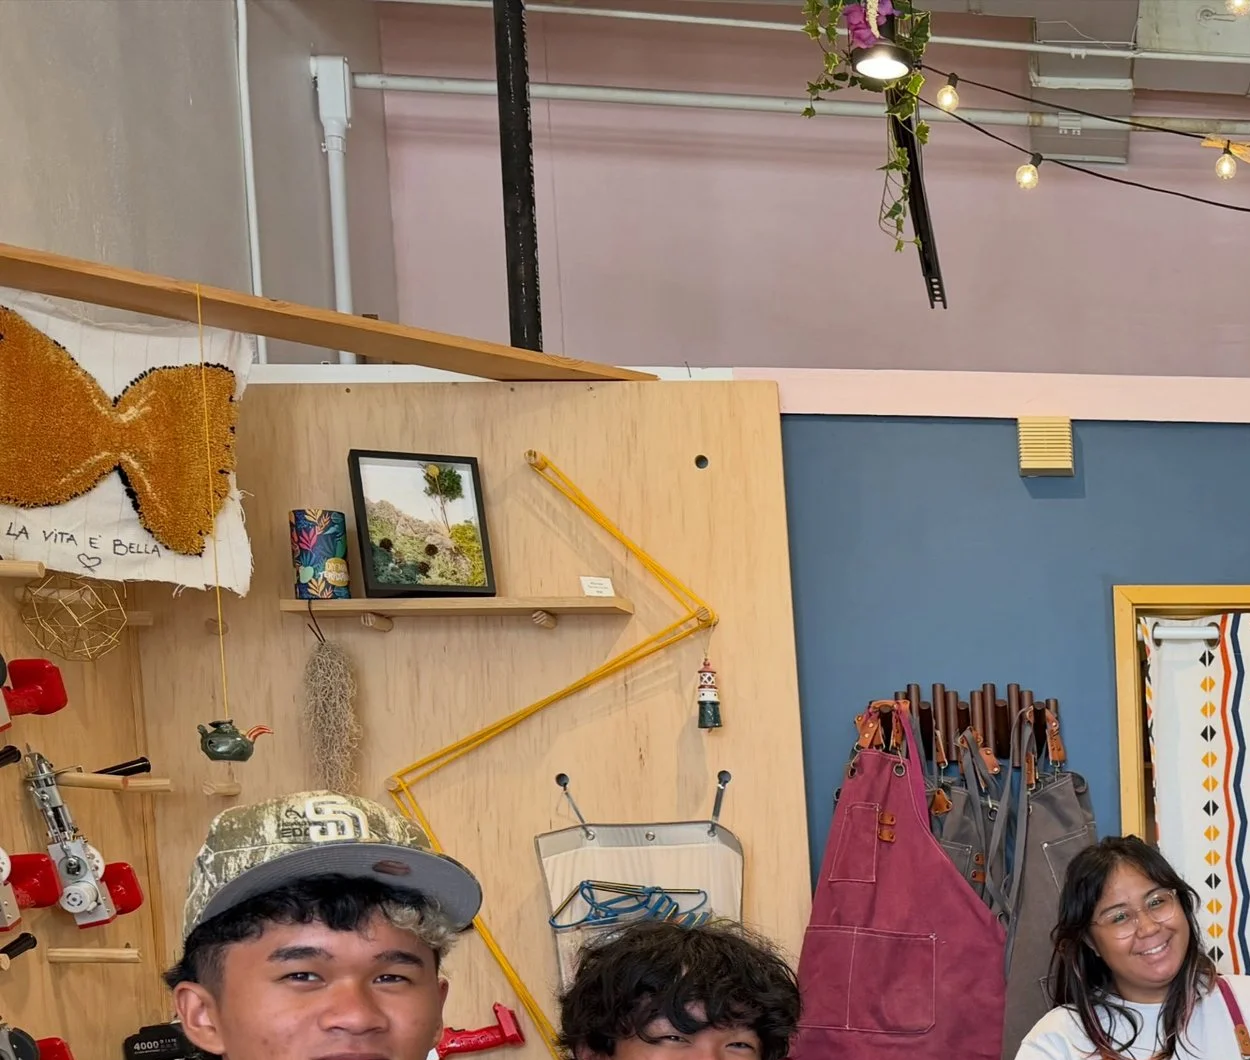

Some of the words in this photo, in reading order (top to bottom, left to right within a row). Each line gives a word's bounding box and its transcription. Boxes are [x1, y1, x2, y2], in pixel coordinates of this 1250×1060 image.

[6, 522, 29, 540] LA
[112, 539, 161, 558] BELLA
[133, 1041, 160, 1051] 4000
